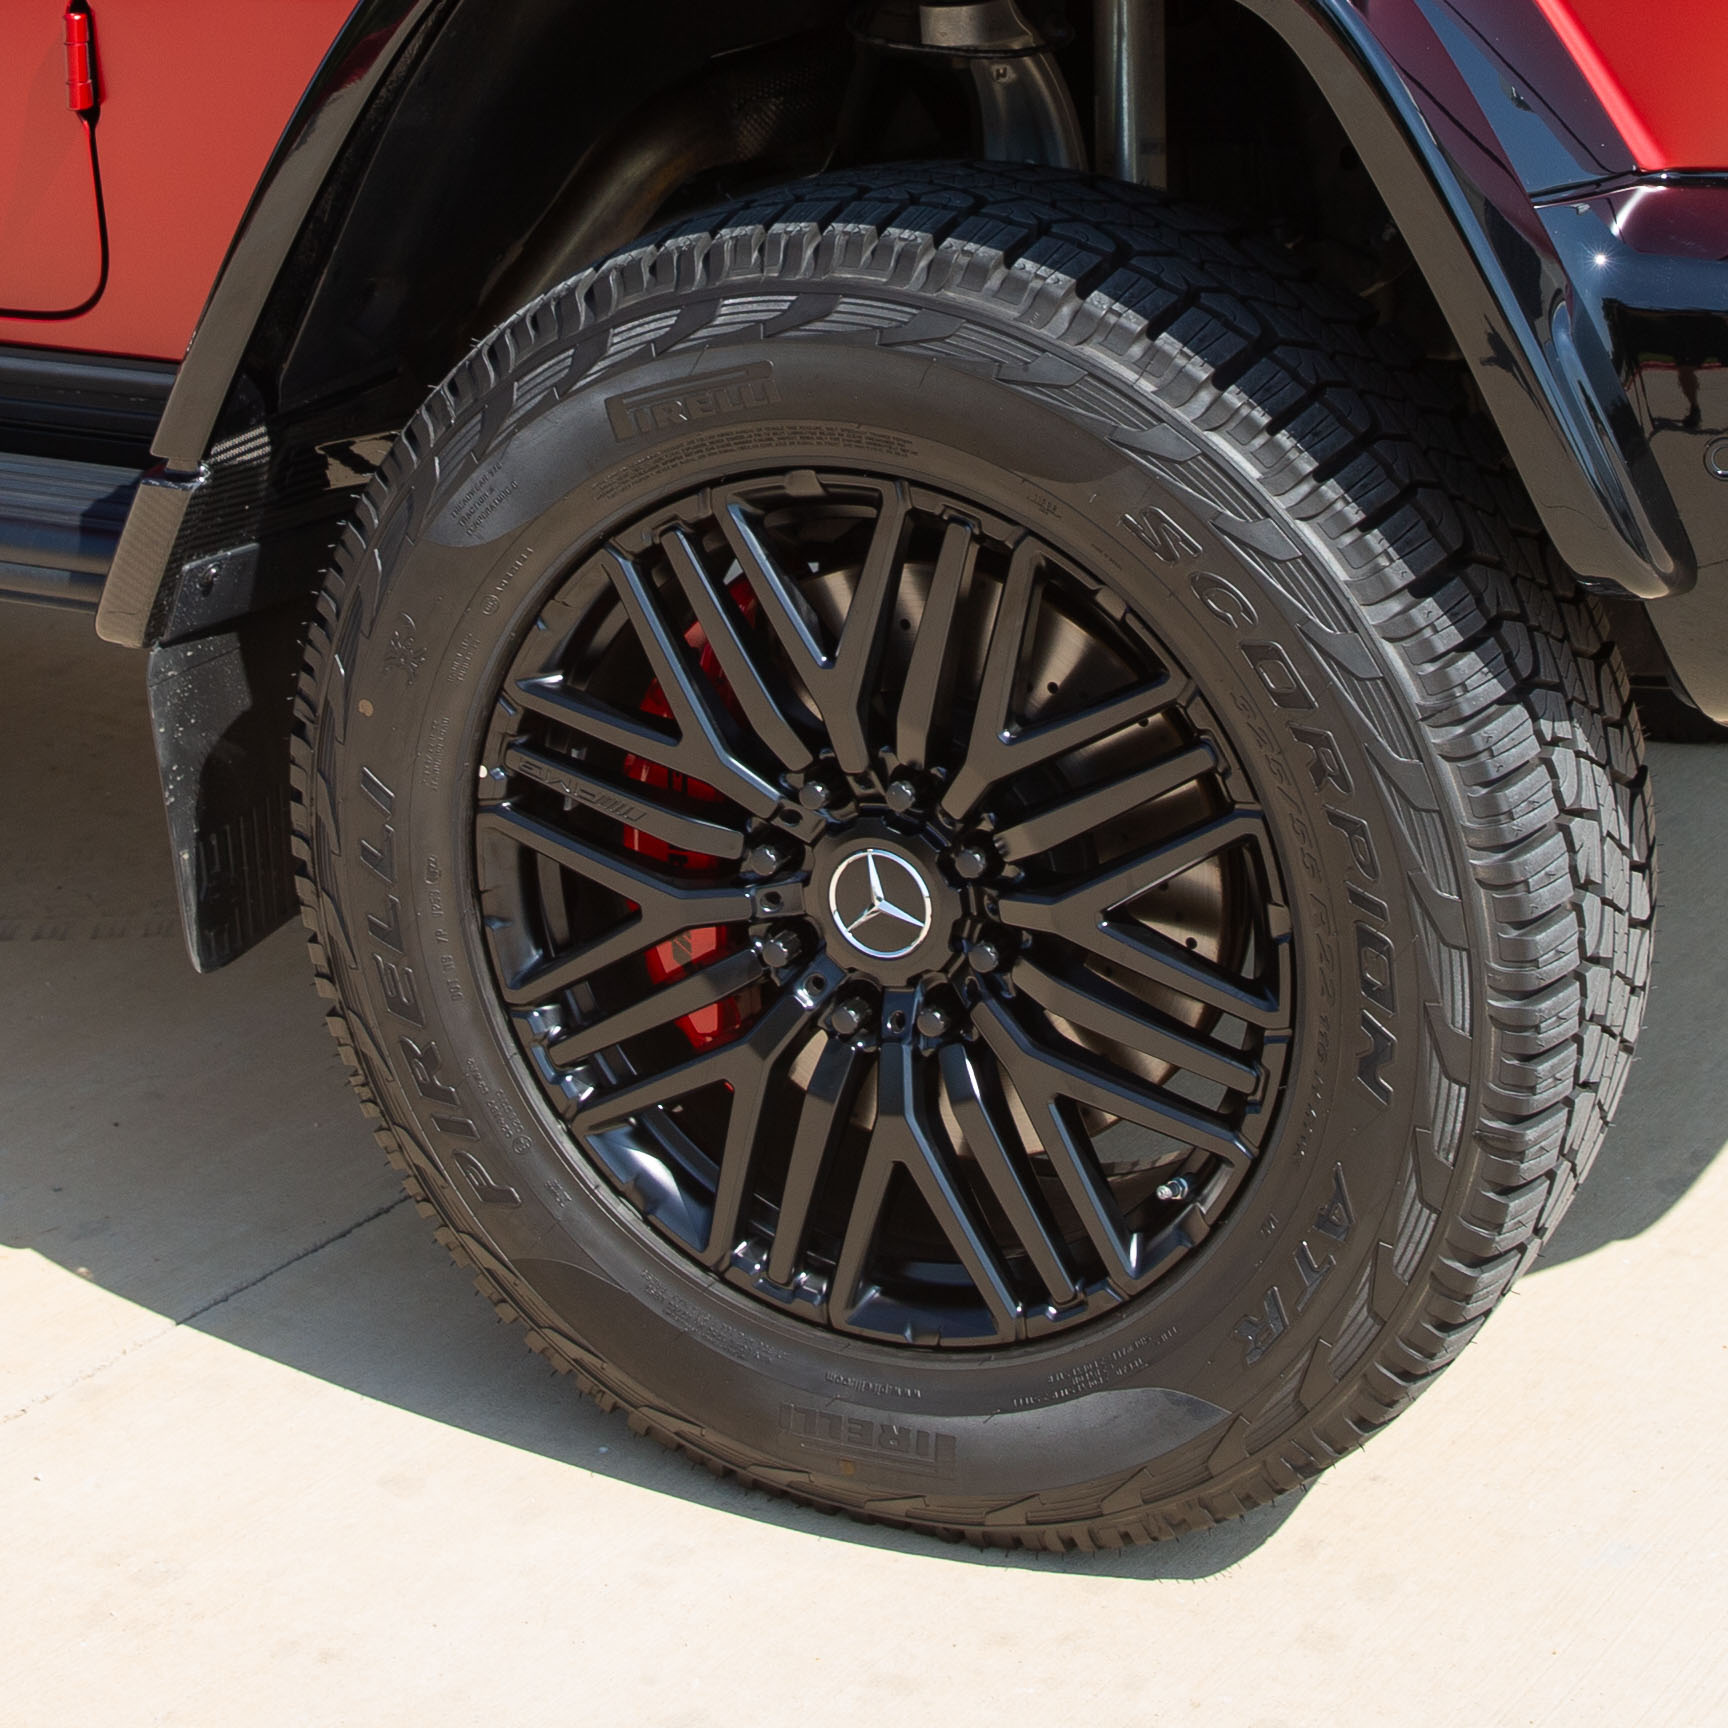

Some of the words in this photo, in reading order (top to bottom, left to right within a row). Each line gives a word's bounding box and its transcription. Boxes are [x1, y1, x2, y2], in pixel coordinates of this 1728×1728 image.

[604, 359, 785, 444] PIRELLI
[1121, 504, 1399, 1108] SCORPION
[360, 766, 522, 1205] PIRELLI
[1232, 1160, 1357, 1366] ATR
[778, 1401, 959, 1467] PIRELLI
